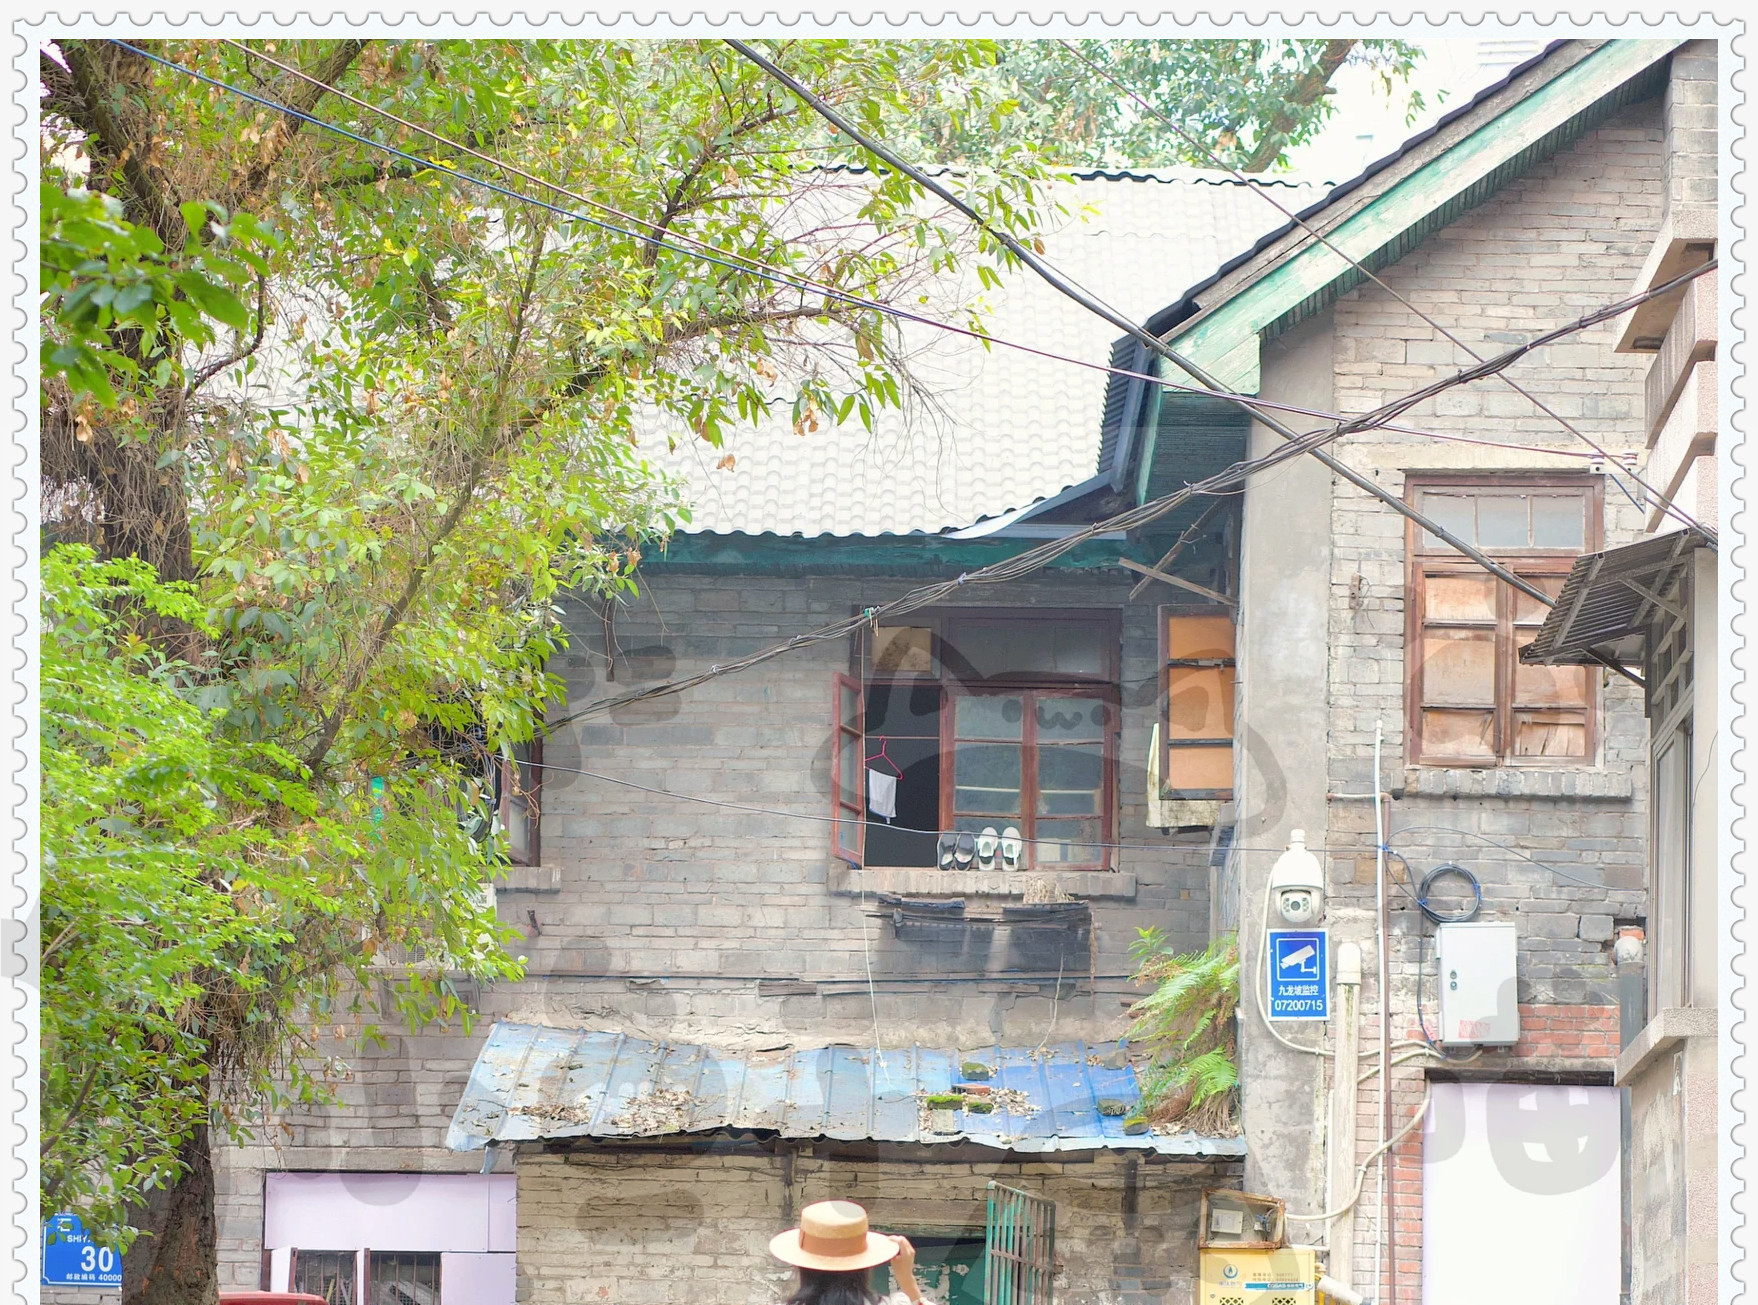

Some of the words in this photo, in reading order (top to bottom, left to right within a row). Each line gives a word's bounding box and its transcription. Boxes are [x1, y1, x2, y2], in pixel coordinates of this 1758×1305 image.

[1279, 985, 1319, 996] 九龙坡监控
[1275, 1000, 1323, 1011] 07200715
[67, 1234, 91, 1243] SHIY
[81, 1246, 114, 1272] 30
